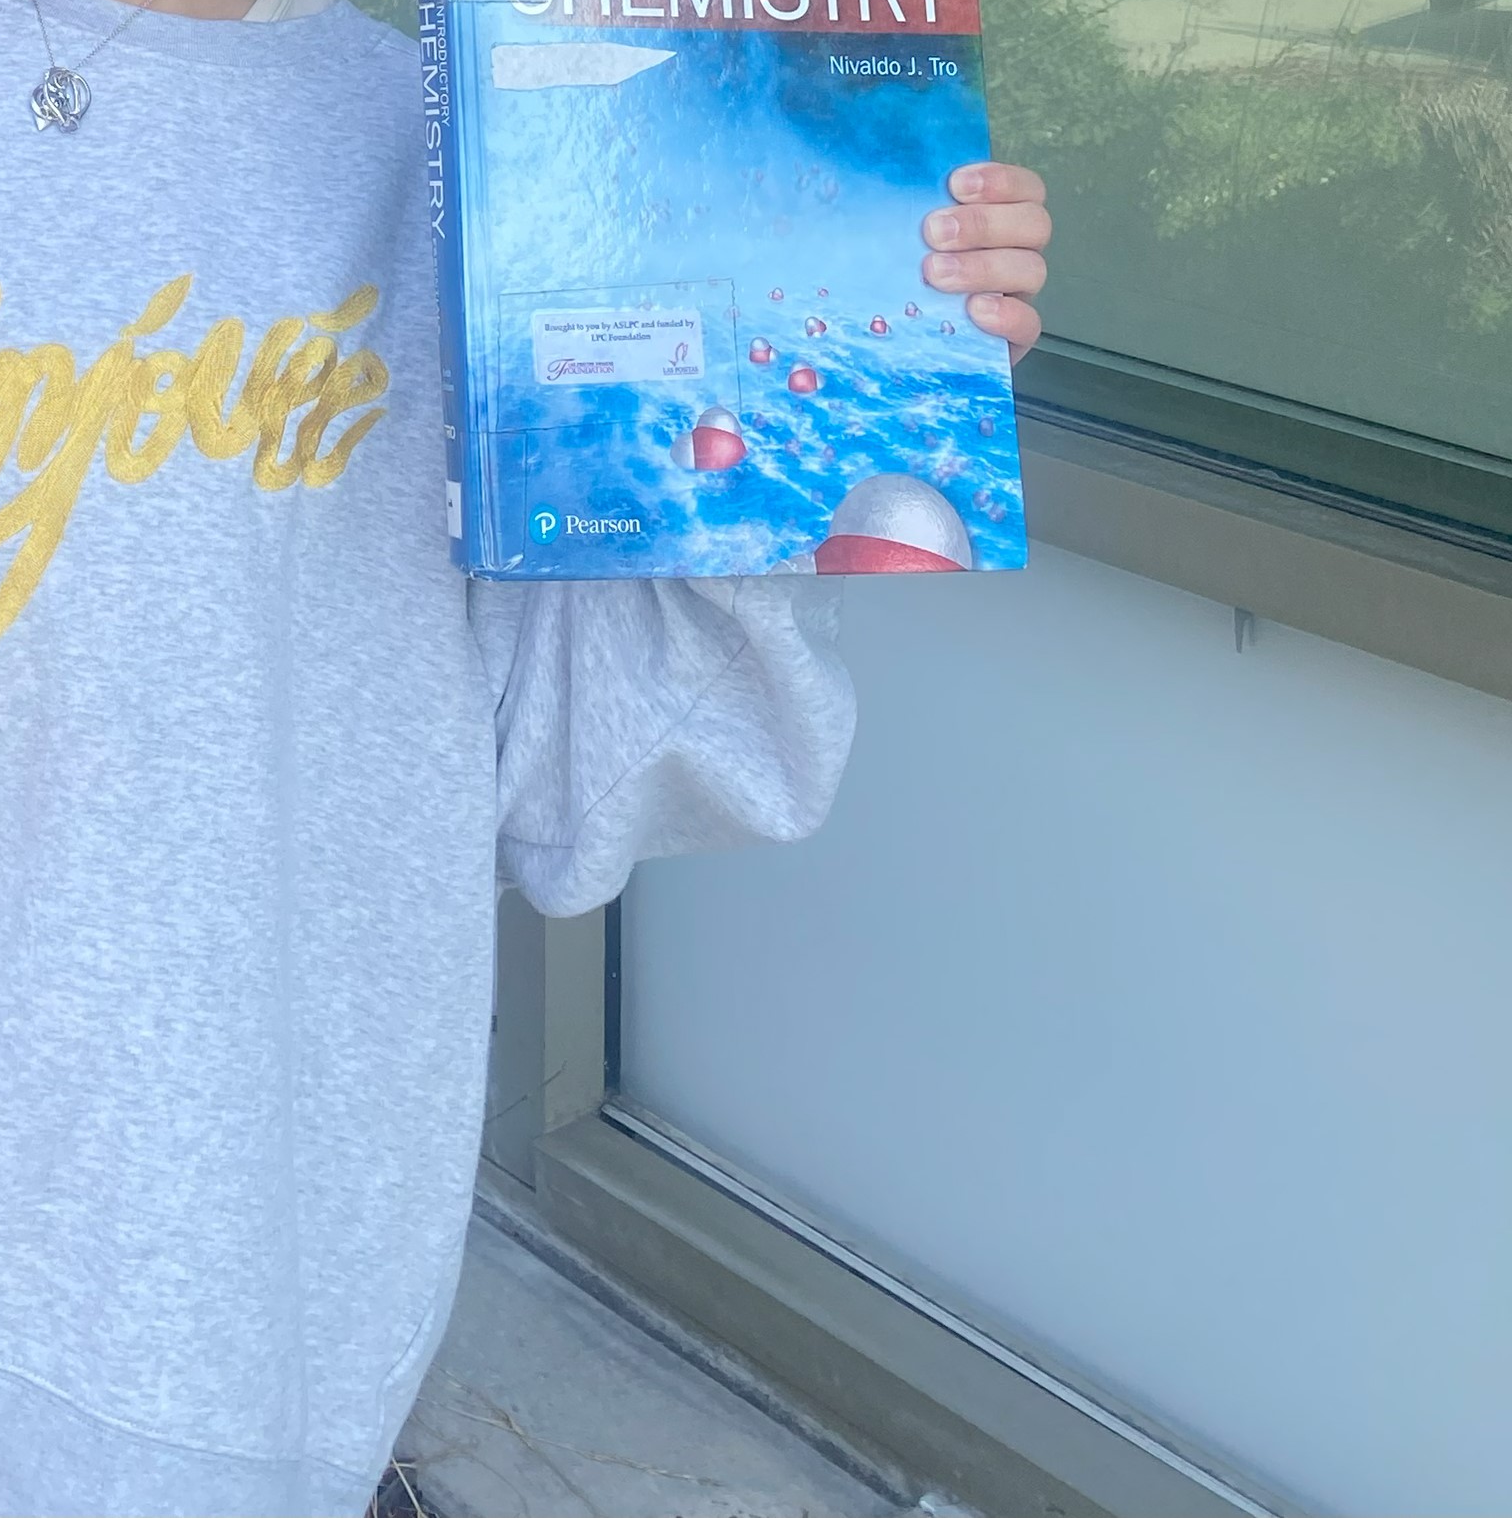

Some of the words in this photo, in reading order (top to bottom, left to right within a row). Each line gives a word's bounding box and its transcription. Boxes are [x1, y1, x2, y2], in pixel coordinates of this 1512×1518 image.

[829, 55, 901, 76] Nivaldo
[907, 56, 923, 76] J.
[928, 57, 958, 76] Tro
[544, 323, 576, 333] Brought
[577, 323, 584, 331] to
[585, 324, 600, 333] you
[601, 322, 611, 332] by
[613, 320, 640, 330] ASLPC
[641, 320, 655, 328] and
[656, 318, 683, 328] funded
[685, 318, 694, 328] by
[591, 333, 607, 342] LPC
[608, 332, 651, 342] Foundation
[565, 515, 642, 535] Pearson
